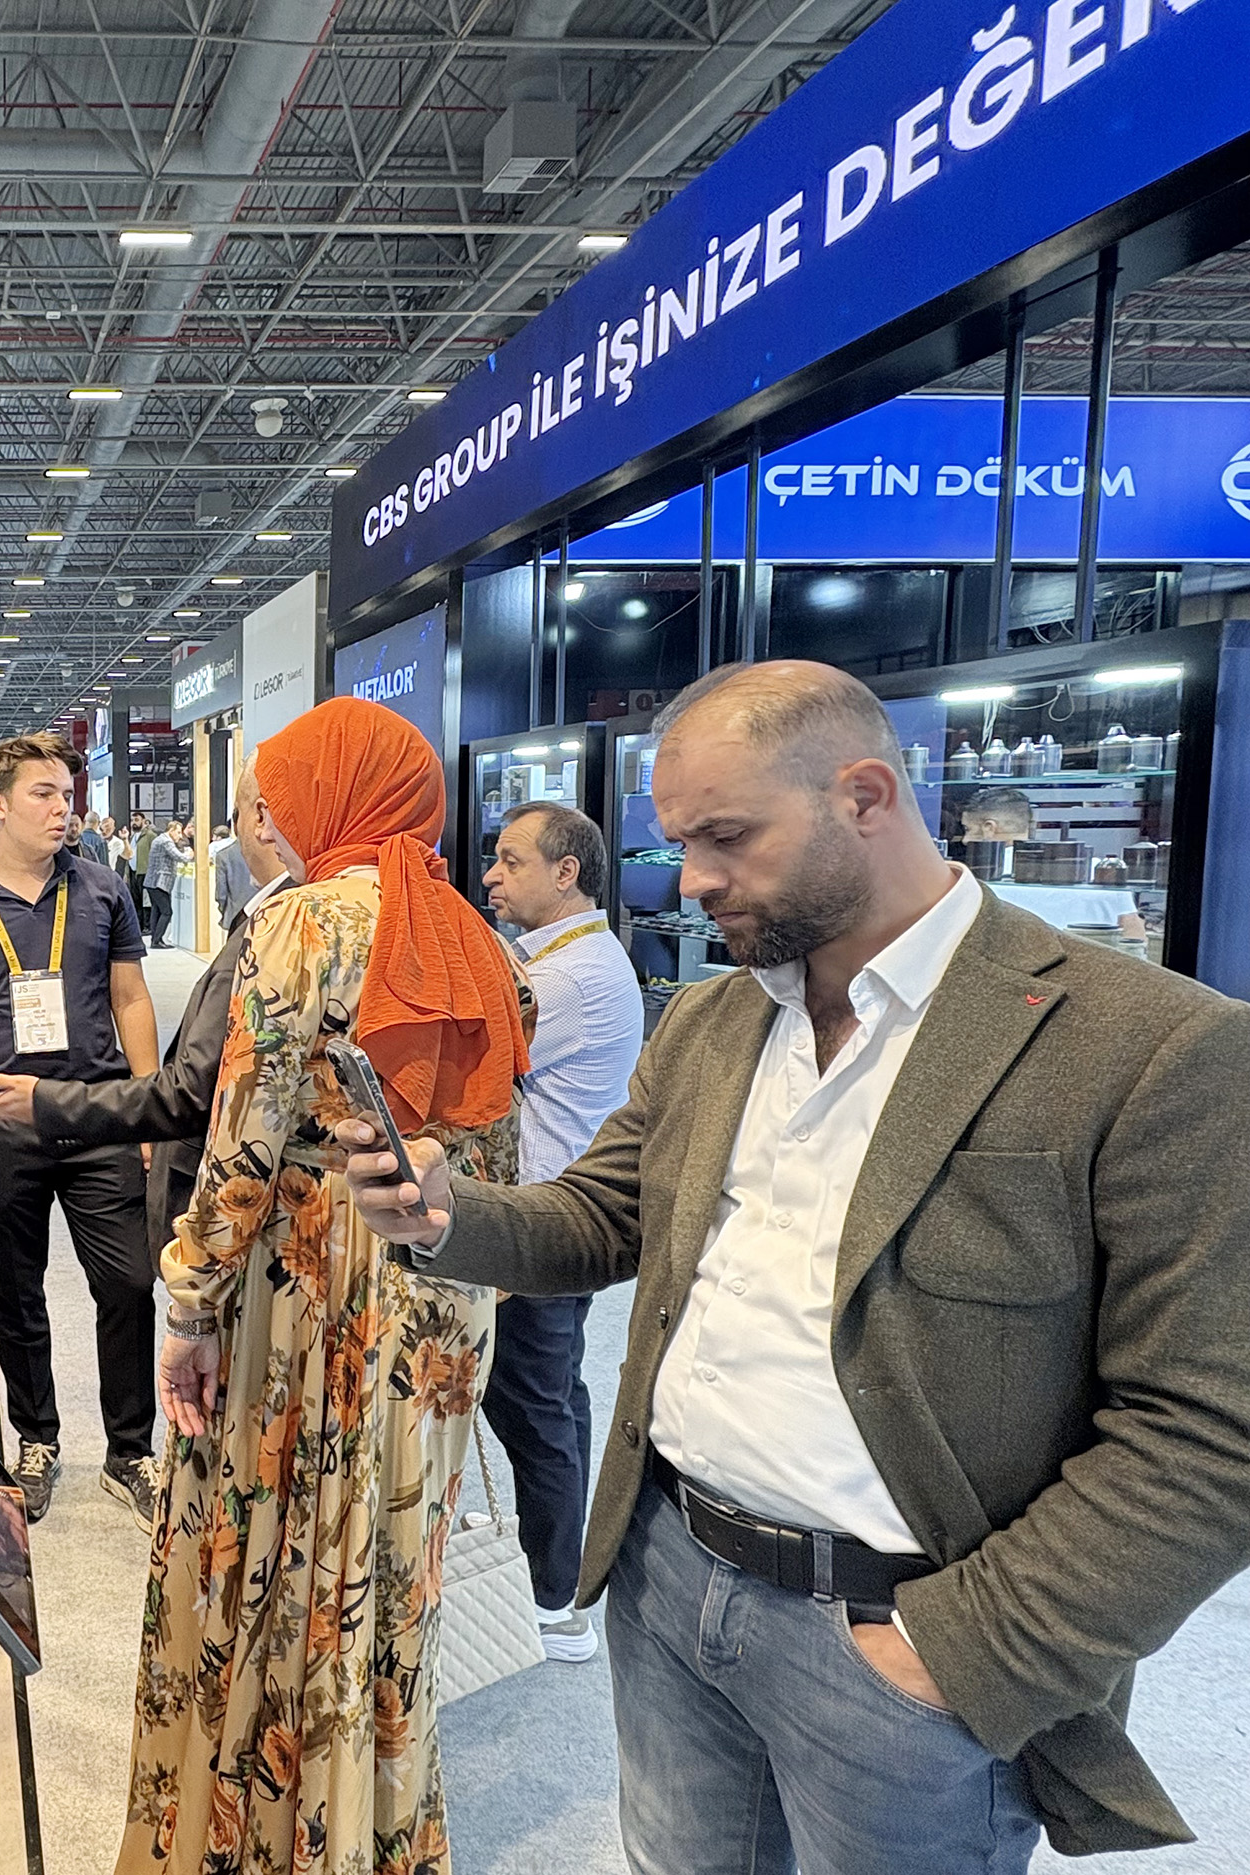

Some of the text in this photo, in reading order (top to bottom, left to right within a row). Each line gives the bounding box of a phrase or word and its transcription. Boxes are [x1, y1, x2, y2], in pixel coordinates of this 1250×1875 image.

[362, 483, 409, 547] CBS
[413, 403, 523, 514] GROUP
[529, 353, 585, 441] İLE
[594, 191, 804, 407] İŞİNİZE
[764, 456, 1137, 507] ÇETİN DÖKÜM
